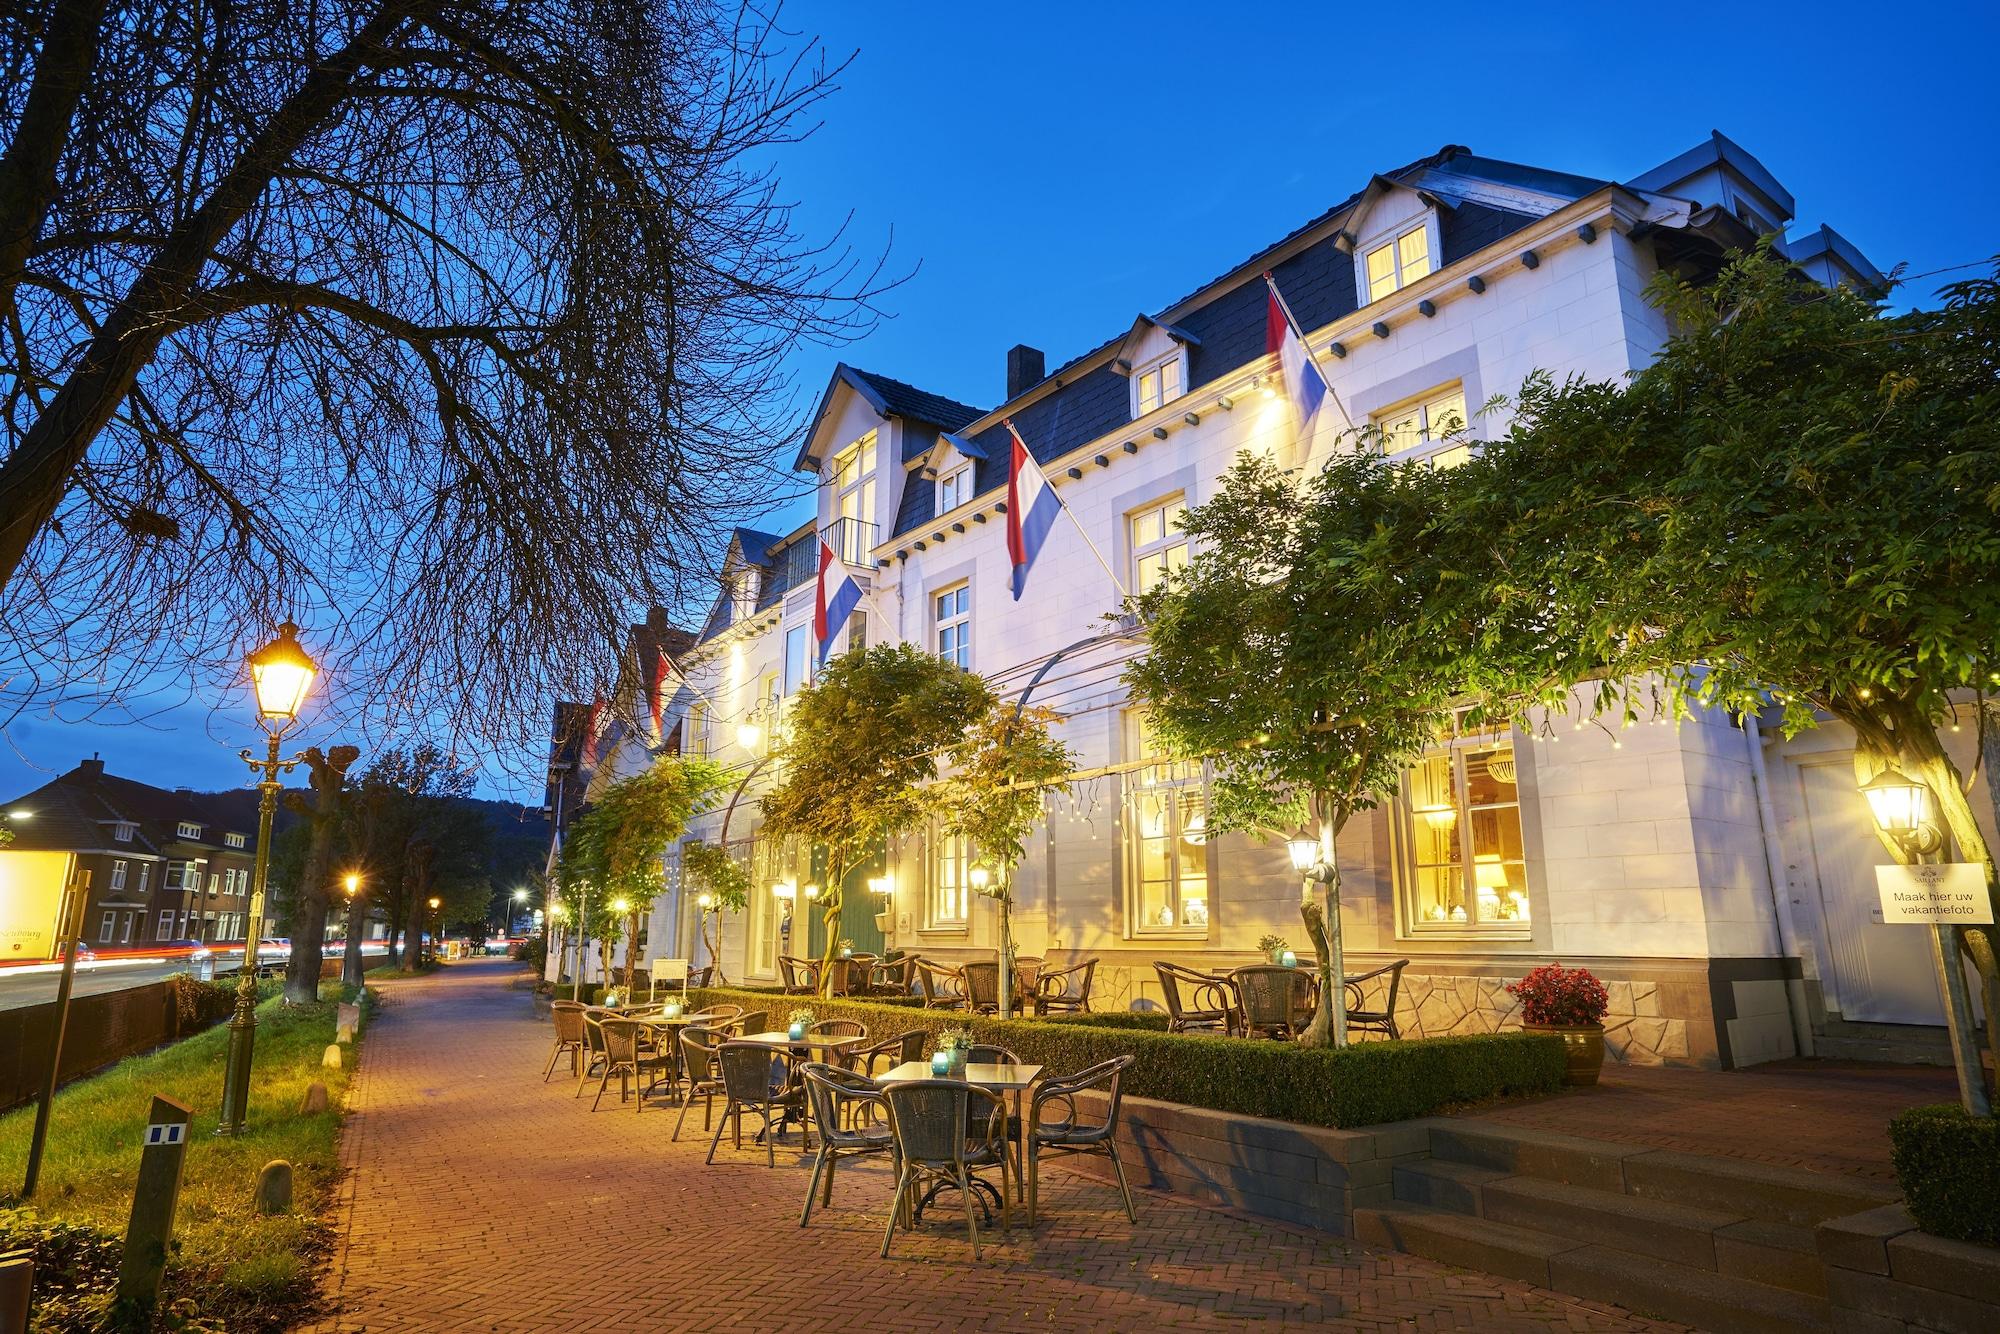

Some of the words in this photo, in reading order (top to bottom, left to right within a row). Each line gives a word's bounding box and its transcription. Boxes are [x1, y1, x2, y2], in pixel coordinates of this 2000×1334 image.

[1894, 892, 1926, 901] Maak
[1929, 892, 1951, 901] hier
[1956, 893, 1973, 901] uw
[1901, 905, 1974, 914] vakantiefoto
